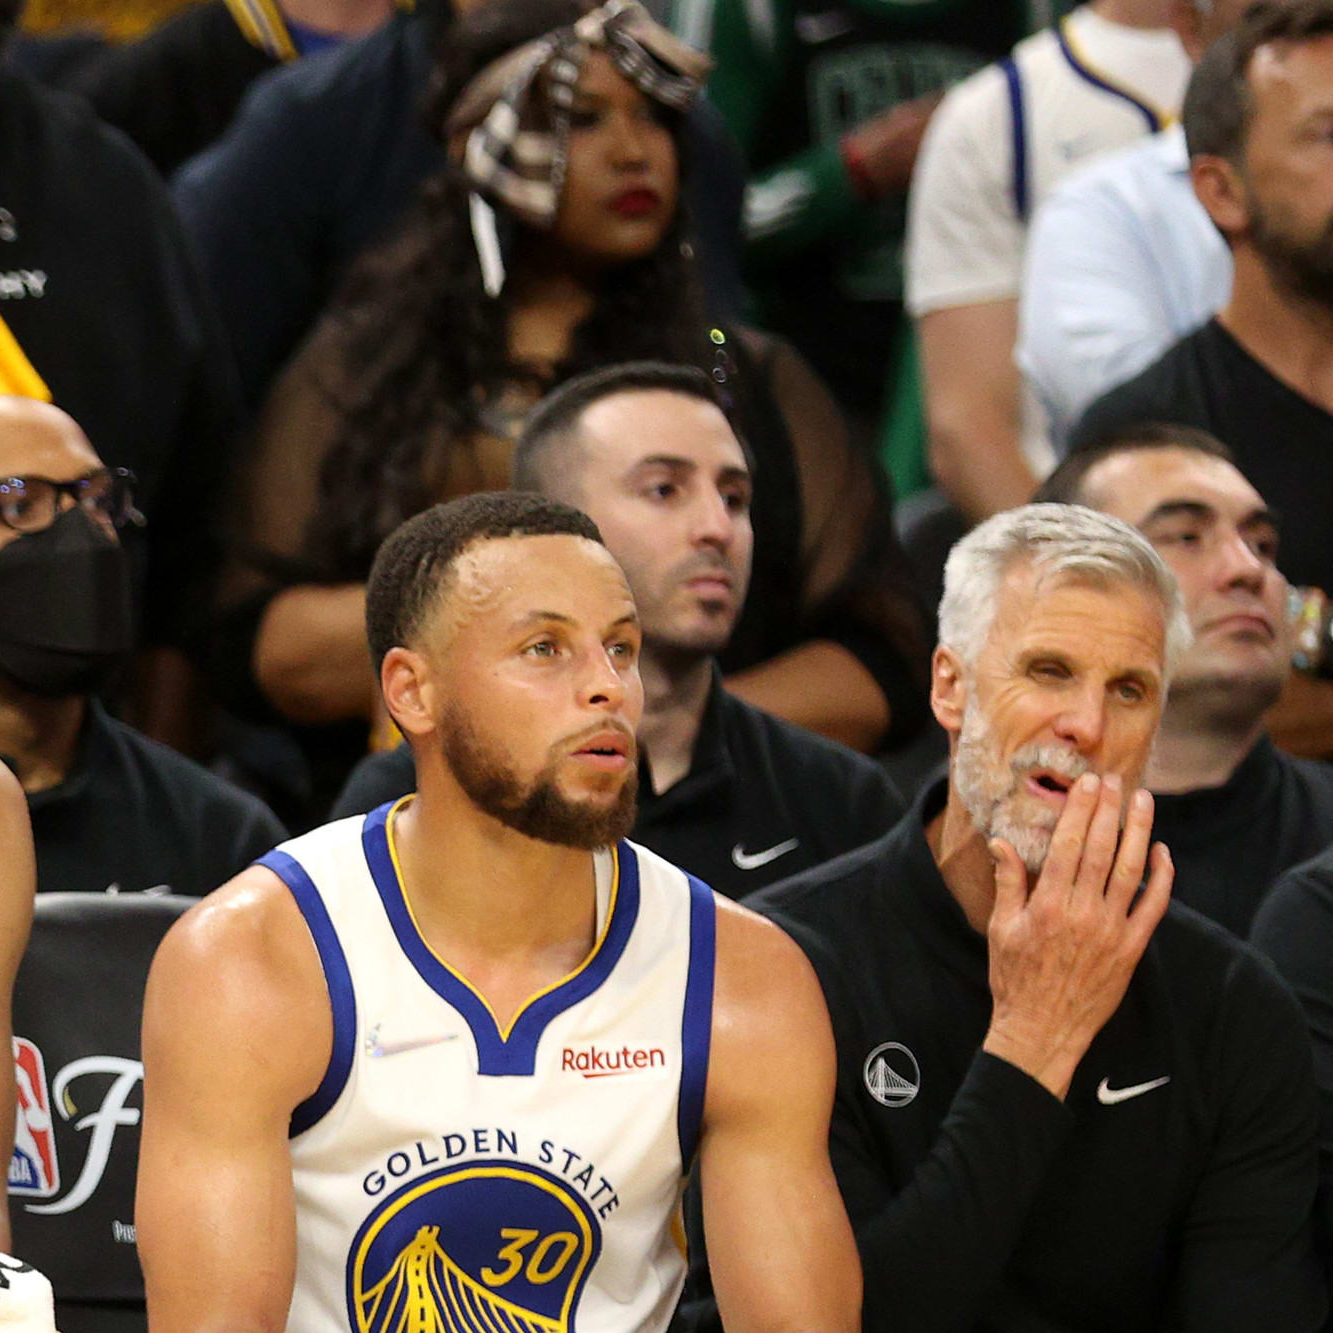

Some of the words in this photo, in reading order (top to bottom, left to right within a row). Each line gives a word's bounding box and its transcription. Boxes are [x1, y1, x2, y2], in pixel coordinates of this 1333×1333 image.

[562, 1045, 666, 1079] Rakuten
[363, 1127, 518, 1197] GOLDEN
[538, 1139, 621, 1223] STATE
[480, 1228, 580, 1287] 30
